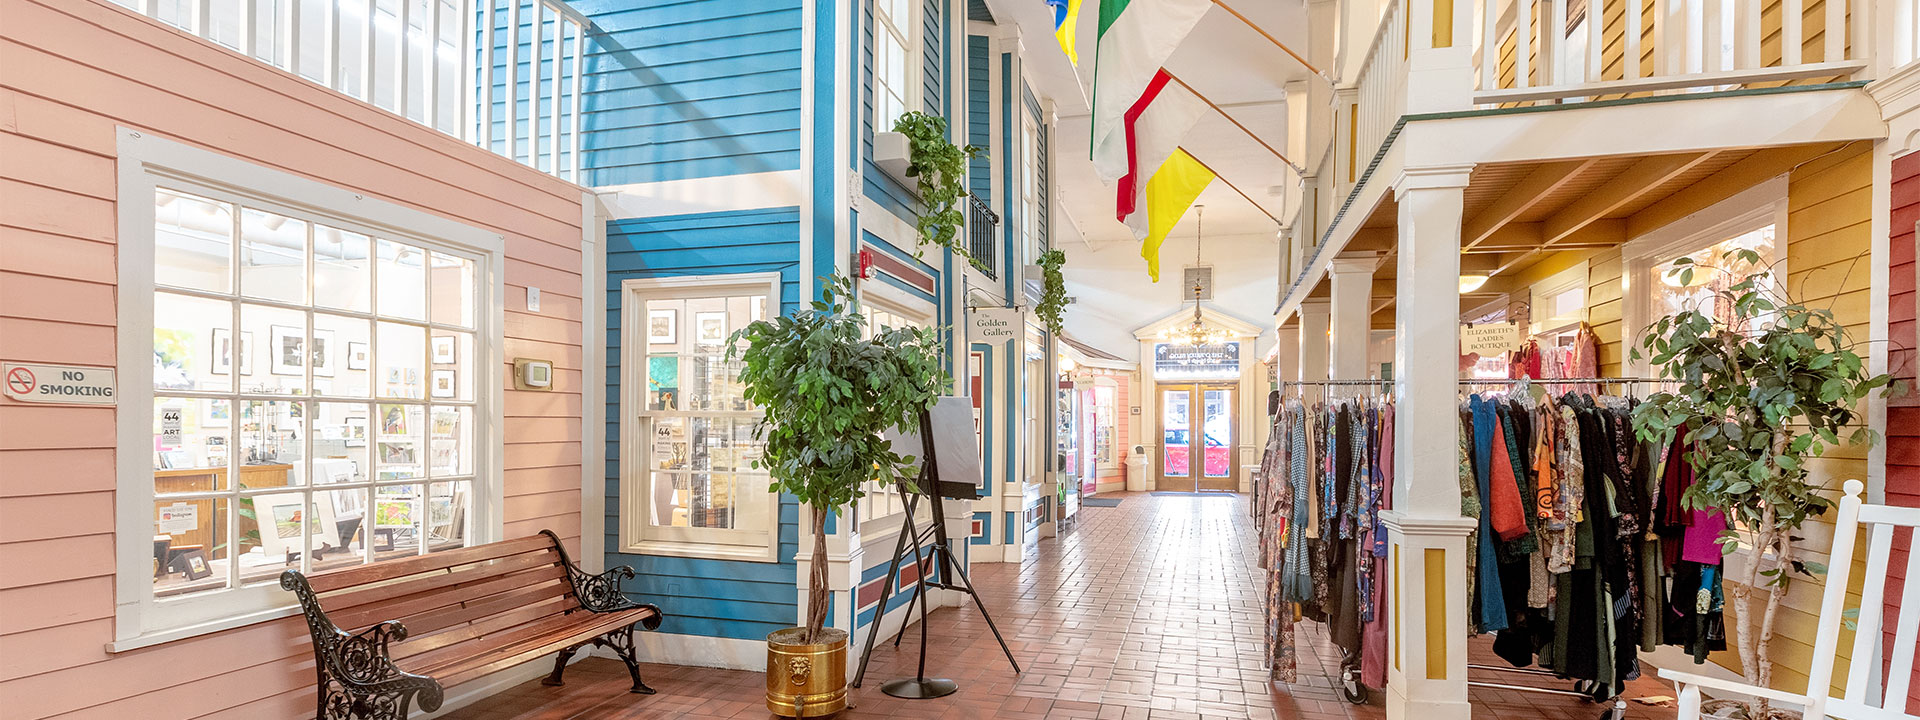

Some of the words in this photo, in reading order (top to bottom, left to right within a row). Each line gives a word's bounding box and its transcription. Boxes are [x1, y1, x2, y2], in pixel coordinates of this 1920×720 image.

[976, 319, 1008, 327] Golden
[983, 328, 1014, 336] Gallery
[1471, 342, 1511, 350] BOUTIQUE
[62, 371, 84, 381] NO
[40, 384, 113, 397] SMOKING
[164, 412, 179, 421] 44
[658, 428, 670, 436] 44
